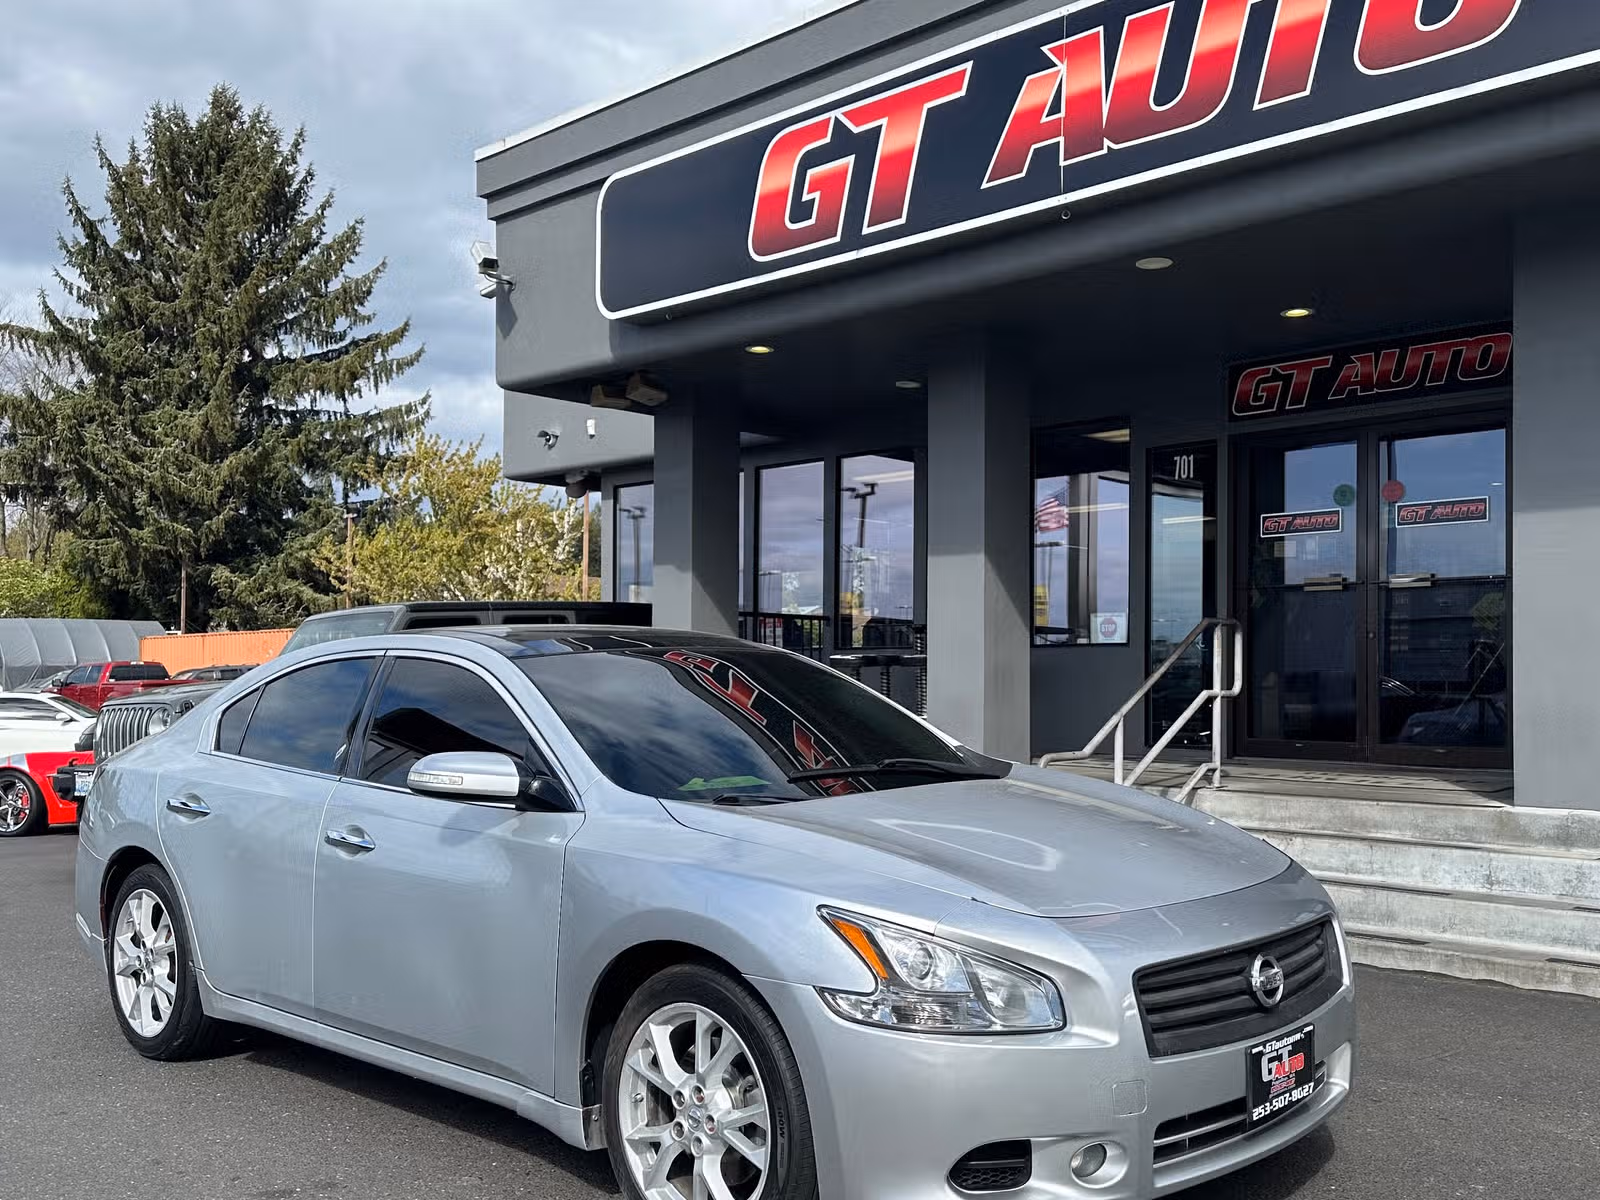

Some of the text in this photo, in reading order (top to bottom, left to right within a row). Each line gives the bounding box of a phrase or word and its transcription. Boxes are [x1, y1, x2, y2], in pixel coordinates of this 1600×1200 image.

[747, 60, 974, 263] GT
[1232, 332, 1513, 416] GT AUTO
[1173, 454, 1194, 480] 701
[1263, 513, 1338, 533] GT AUTO
[1399, 502, 1485, 523] GT AUTO
[1261, 1045, 1293, 1083] GT
[1252, 1082, 1315, 1121] 253-507-8027
